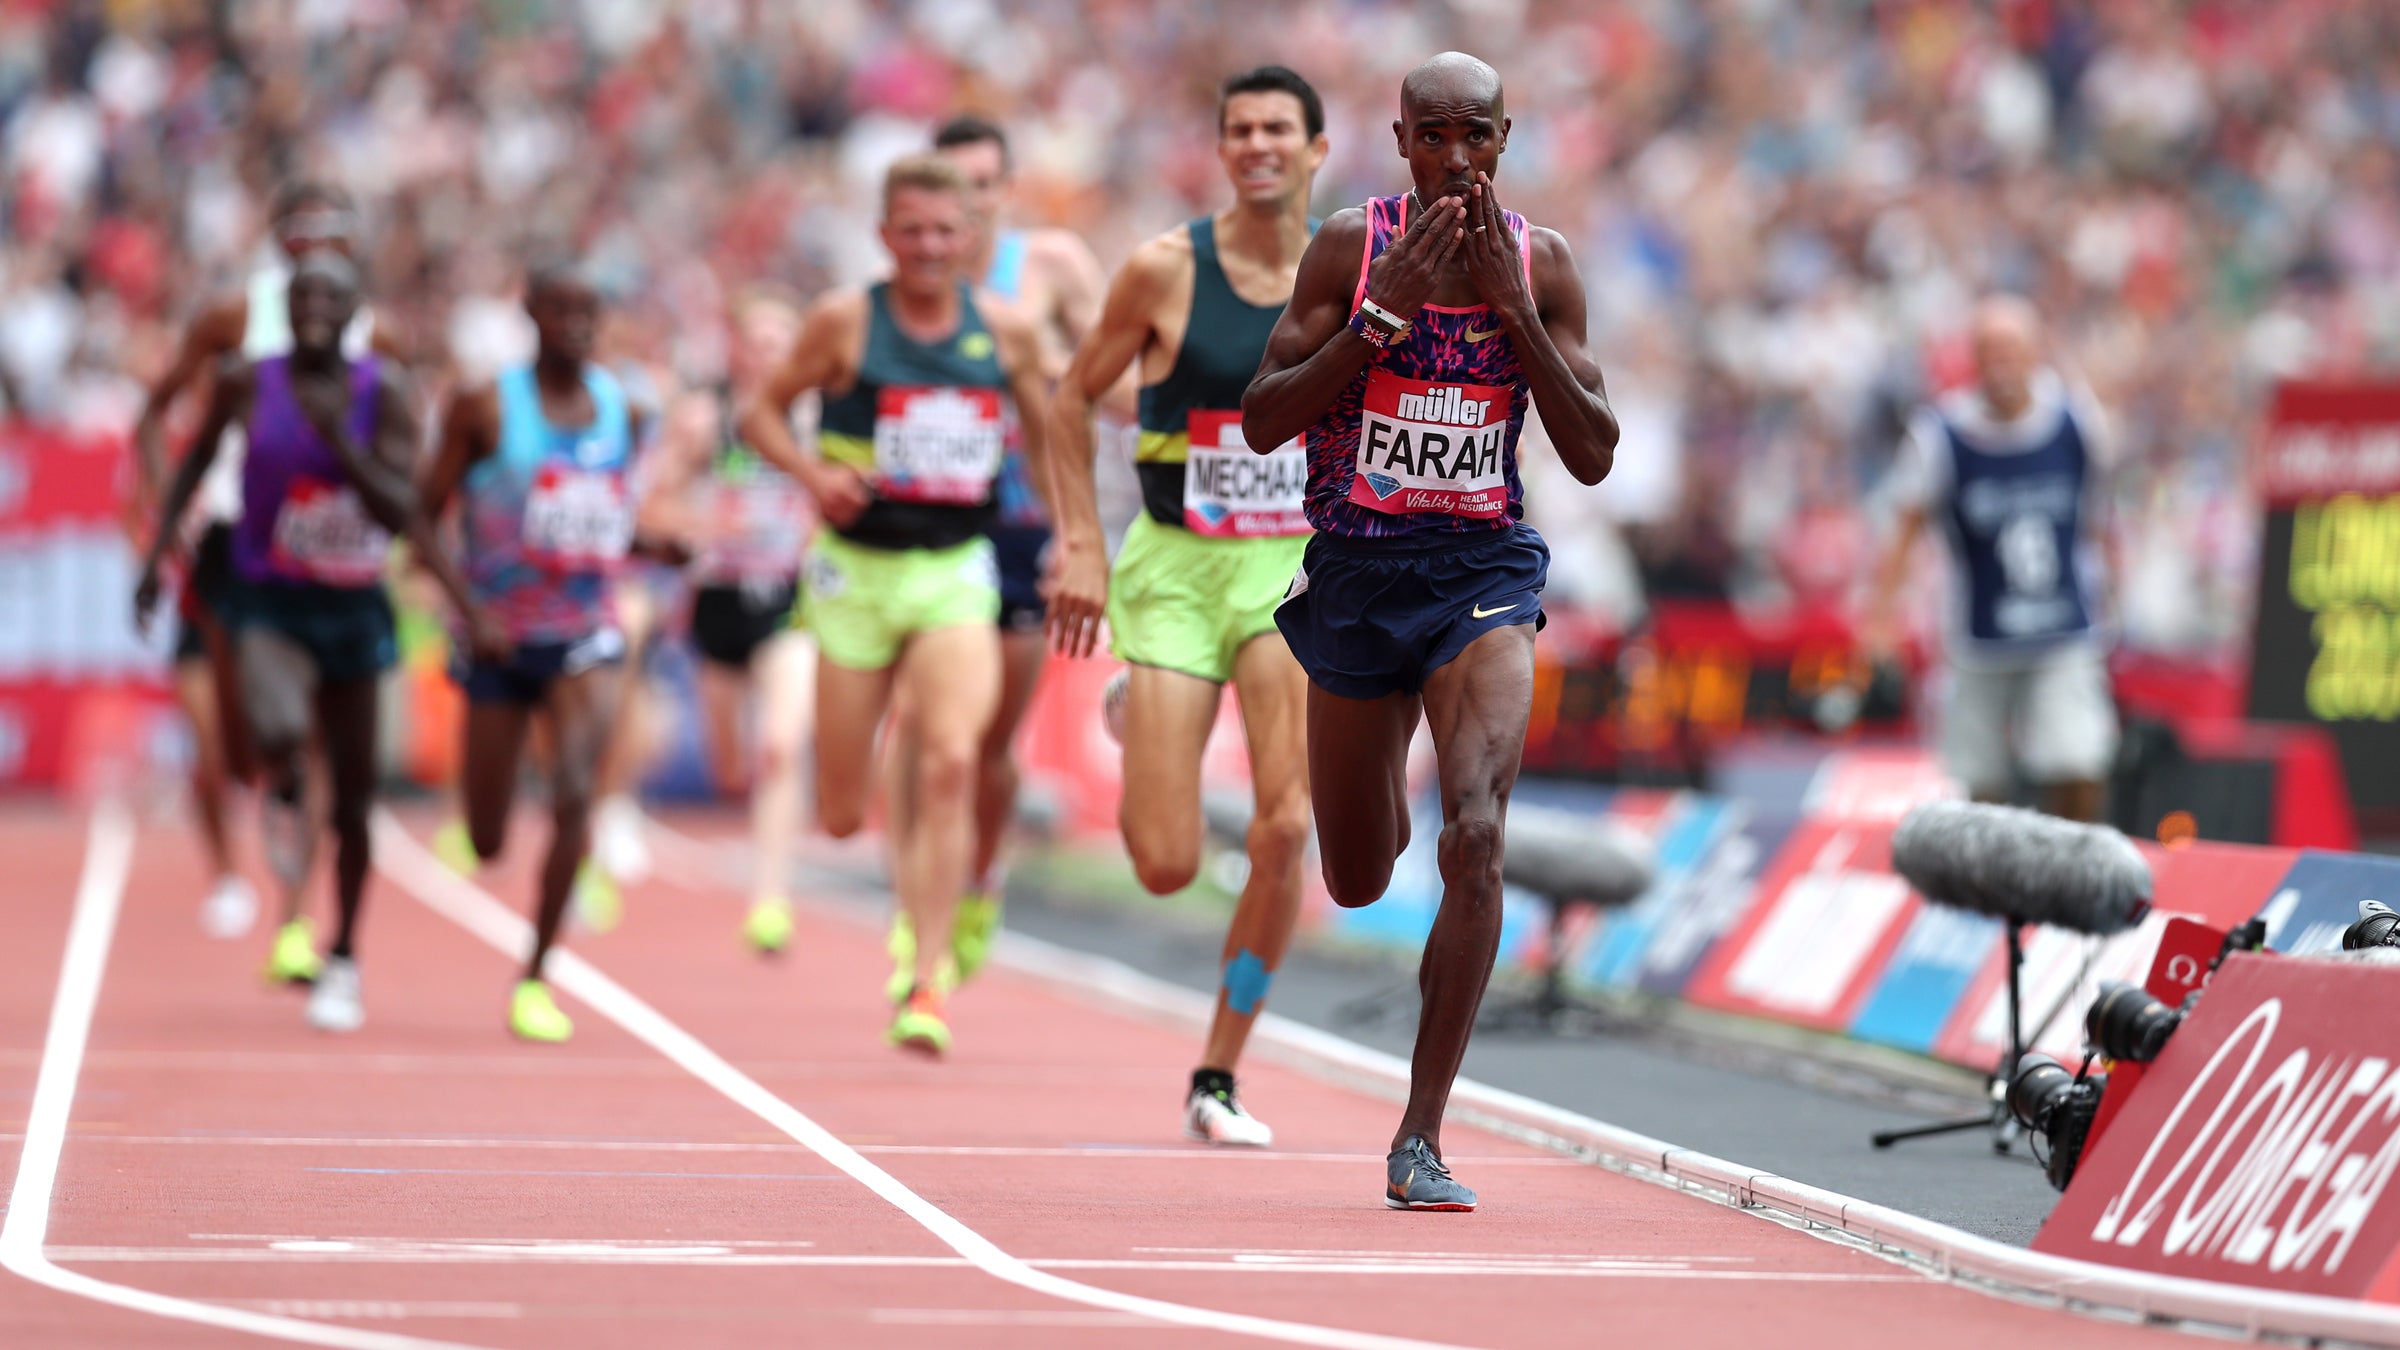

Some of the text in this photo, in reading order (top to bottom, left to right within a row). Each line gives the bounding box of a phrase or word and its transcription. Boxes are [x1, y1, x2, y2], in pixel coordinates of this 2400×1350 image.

[1397, 386, 1491, 426] müller
[1364, 419, 1500, 480] FARAH
[1406, 490, 1488, 513] Vitality HEALTH
[1458, 500, 1503, 512] INSURANCE
[2162, 1047, 2400, 1275] OMEGA
